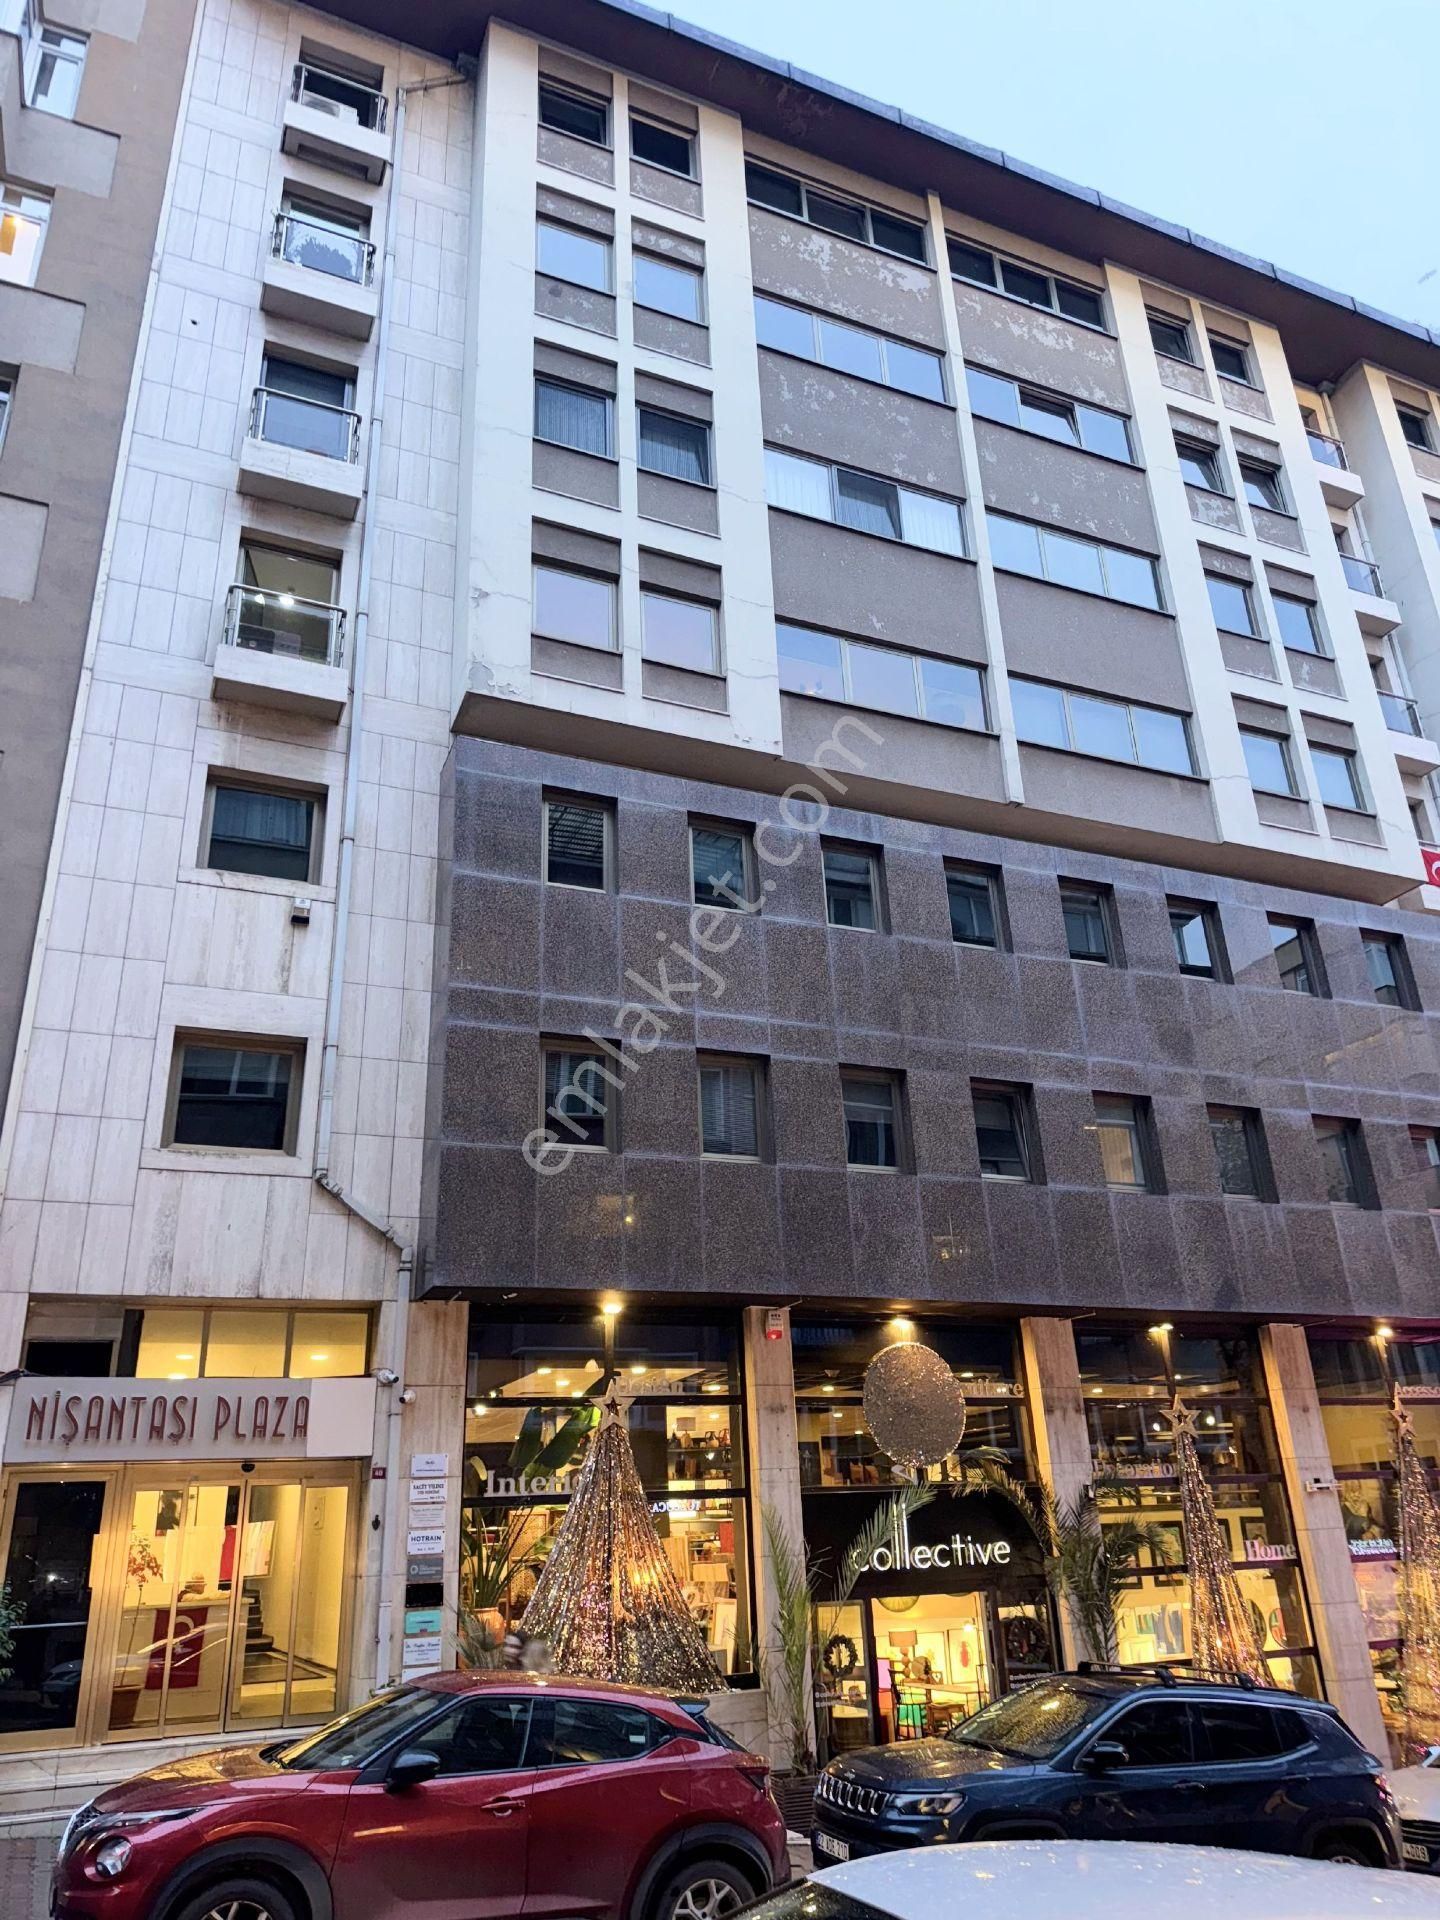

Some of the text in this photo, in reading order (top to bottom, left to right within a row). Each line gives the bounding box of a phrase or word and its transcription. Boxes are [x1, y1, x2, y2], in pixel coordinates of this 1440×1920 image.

[25, 1391, 311, 1446] NİŞANTAŞI PLAZA
[852, 1502, 1011, 1572] collective
[1244, 1539, 1298, 1562] Home
